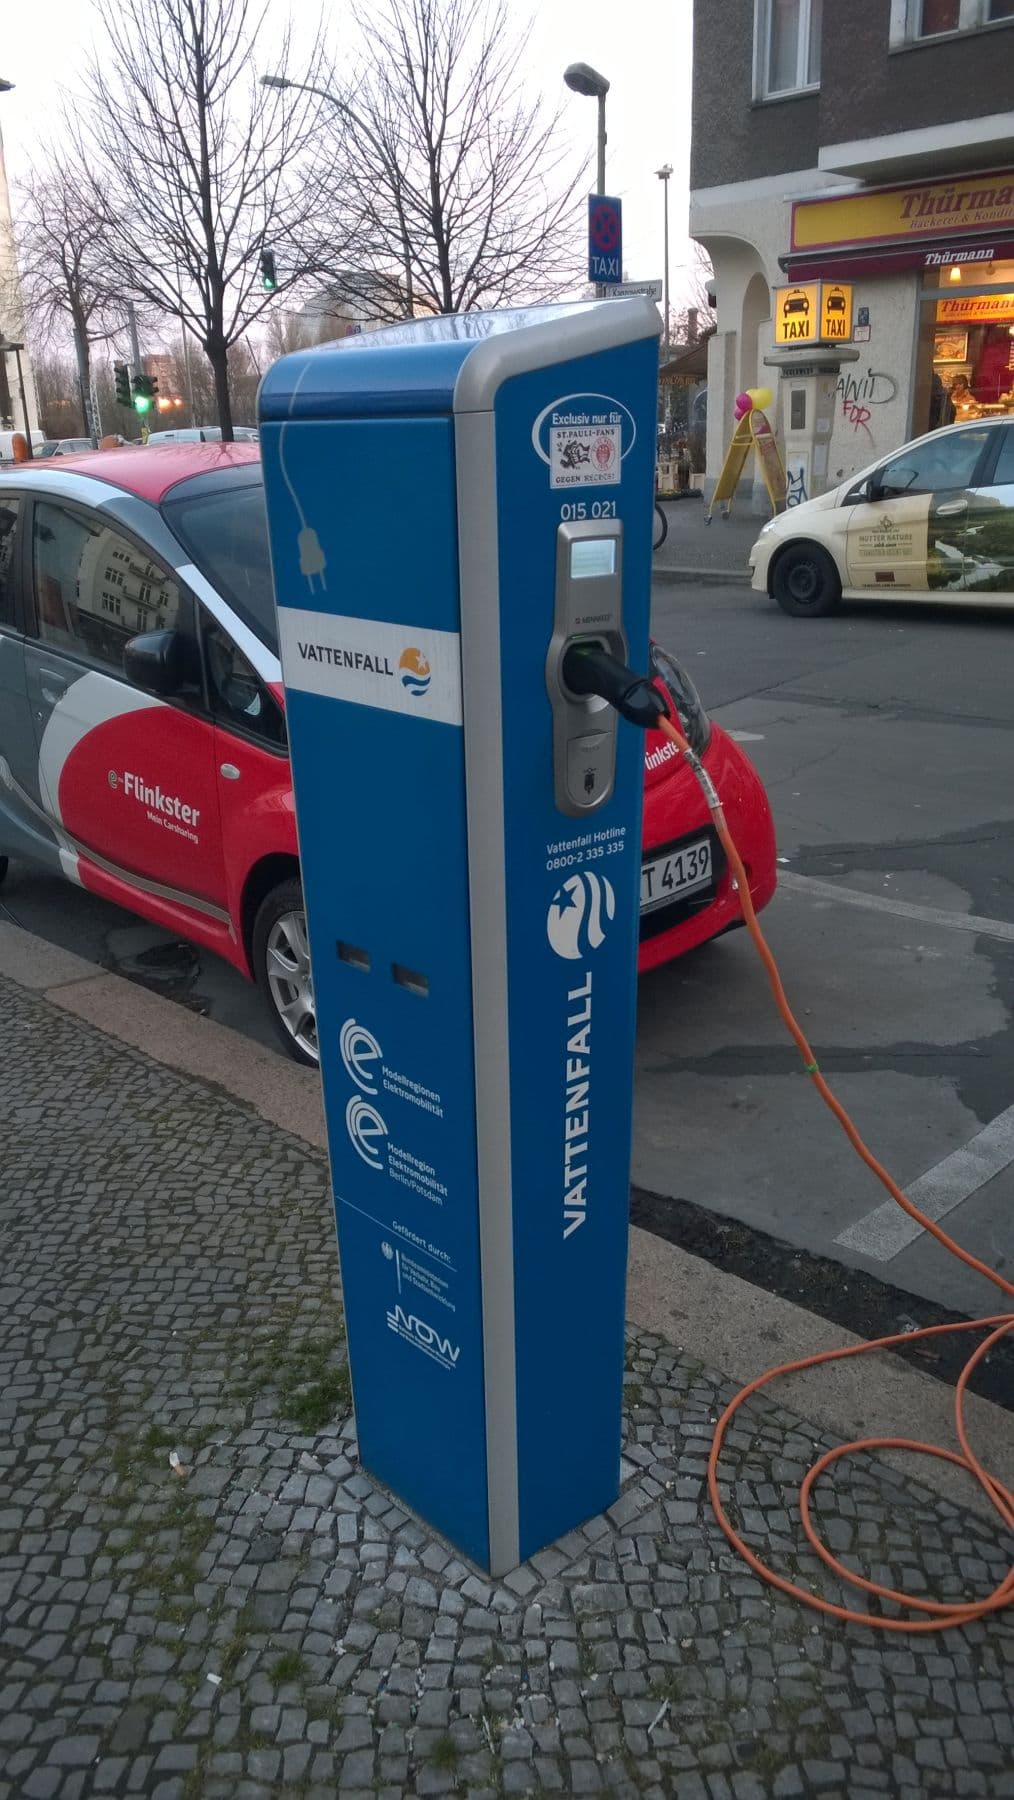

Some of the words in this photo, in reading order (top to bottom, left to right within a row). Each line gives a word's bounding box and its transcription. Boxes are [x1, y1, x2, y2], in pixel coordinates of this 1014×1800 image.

[900, 186, 1014, 219] Thürma
[592, 256, 619, 276] TAXI
[924, 249, 994, 265] Thürmann
[942, 299, 1014, 312] Thürman
[783, 319, 809, 339] TAXI
[826, 318, 845, 336] TAXI
[592, 414, 607, 424] nur
[609, 411, 622, 423] für
[555, 475, 581, 484] GEGEN
[560, 502, 587, 520] 015
[591, 501, 616, 518] 021
[297, 642, 394, 676] VATTENFALL
[644, 741, 680, 770] linkste
[147, 810, 163, 826] Mein
[163, 818, 199, 845] Carsharing
[546, 834, 592, 854] Vattenfall
[594, 826, 626, 842] Hotline
[546, 851, 583, 871] 0800-2
[586, 846, 604, 860] 335
[606, 841, 624, 854] 335
[640, 866, 656, 898] T
[661, 845, 709, 890] 4139
[382, 1064, 441, 1103] Modellregionen
[383, 1079, 444, 1119] Elektromobilität
[563, 971, 592, 1240] VATTENFALL
[387, 1142, 436, 1176] Modellregion
[388, 1154, 448, 1197] Elektromobilität
[389, 1167, 443, 1206] Berlin/Potsdam
[393, 1220, 427, 1248] Gefördert
